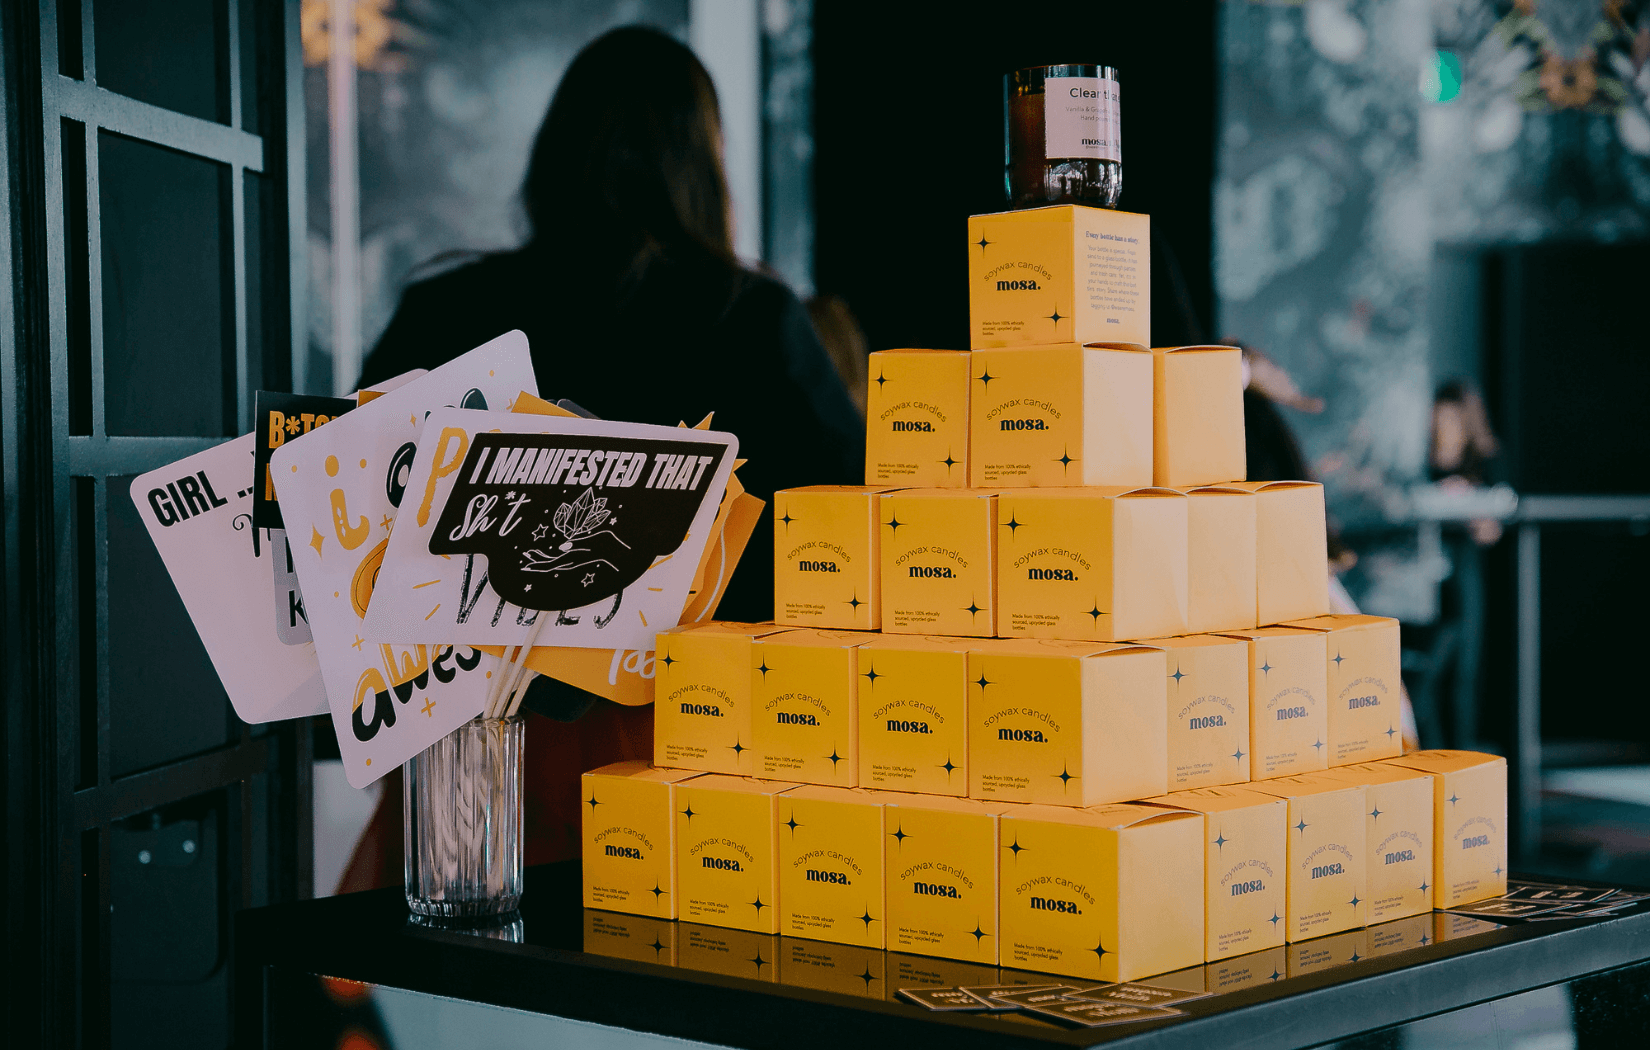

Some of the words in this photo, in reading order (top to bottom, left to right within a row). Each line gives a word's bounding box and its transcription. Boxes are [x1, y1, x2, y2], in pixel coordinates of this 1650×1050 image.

[1069, 87, 1101, 99] Clear
[984, 262, 1015, 282] soywax
[1017, 261, 1052, 280] candles
[996, 280, 1041, 291] mosa.
[880, 401, 911, 421] soywax
[913, 401, 946, 422] candles
[986, 399, 1021, 421] soywax
[1023, 398, 1061, 419] candles
[892, 421, 935, 432] mosa.
[1000, 419, 1049, 431] mosa.
[469, 447, 491, 484] I
[485, 447, 647, 487] MANIFESTED
[645, 453, 714, 491] THAT
[147, 469, 229, 528] GIRL
[787, 541, 816, 561] soywax
[818, 541, 851, 563] candles
[895, 546, 929, 566] soywax
[931, 546, 968, 568] candles
[1014, 547, 1049, 568] soywax
[1052, 548, 1091, 570] candles
[799, 560, 840, 573] mosa.
[909, 566, 956, 578] mosa.
[1028, 568, 1078, 581] mosa.
[668, 684, 699, 702] soywax
[701, 685, 735, 708] candles
[765, 692, 795, 712] soywax
[797, 693, 831, 716] candles
[1348, 695, 1381, 710] mosa.
[680, 703, 724, 717] mosa.
[873, 699, 906, 719] soywax
[908, 700, 945, 724] candles
[777, 712, 820, 726] mosa.
[887, 720, 933, 734] mosa.
[984, 707, 1019, 728] soywax
[1021, 708, 1060, 732] candles
[1190, 715, 1227, 730] mosa.
[998, 728, 1048, 743] mosa.
[594, 826, 621, 844] soywax
[623, 827, 654, 851] candles
[605, 845, 644, 860] mosa.
[690, 837, 719, 856] soywax
[721, 838, 754, 863] candles
[1301, 844, 1327, 870] soywax
[1328, 843, 1353, 861] candles
[1385, 849, 1415, 865] mosa.
[702, 857, 744, 872] mosa.
[793, 850, 825, 868] soywax
[827, 850, 862, 876] candles
[1311, 863, 1345, 879] mosa.
[806, 869, 851, 885] mosa.
[900, 862, 934, 881] soywax
[936, 863, 974, 889] candles
[1220, 860, 1247, 886] soywax
[1248, 859, 1274, 878] candles
[914, 882, 962, 899] mosa.
[1016, 876, 1052, 895] soywax
[1055, 877, 1095, 905] candles
[1231, 879, 1265, 896] mosa.
[1030, 897, 1082, 915] mosa.
